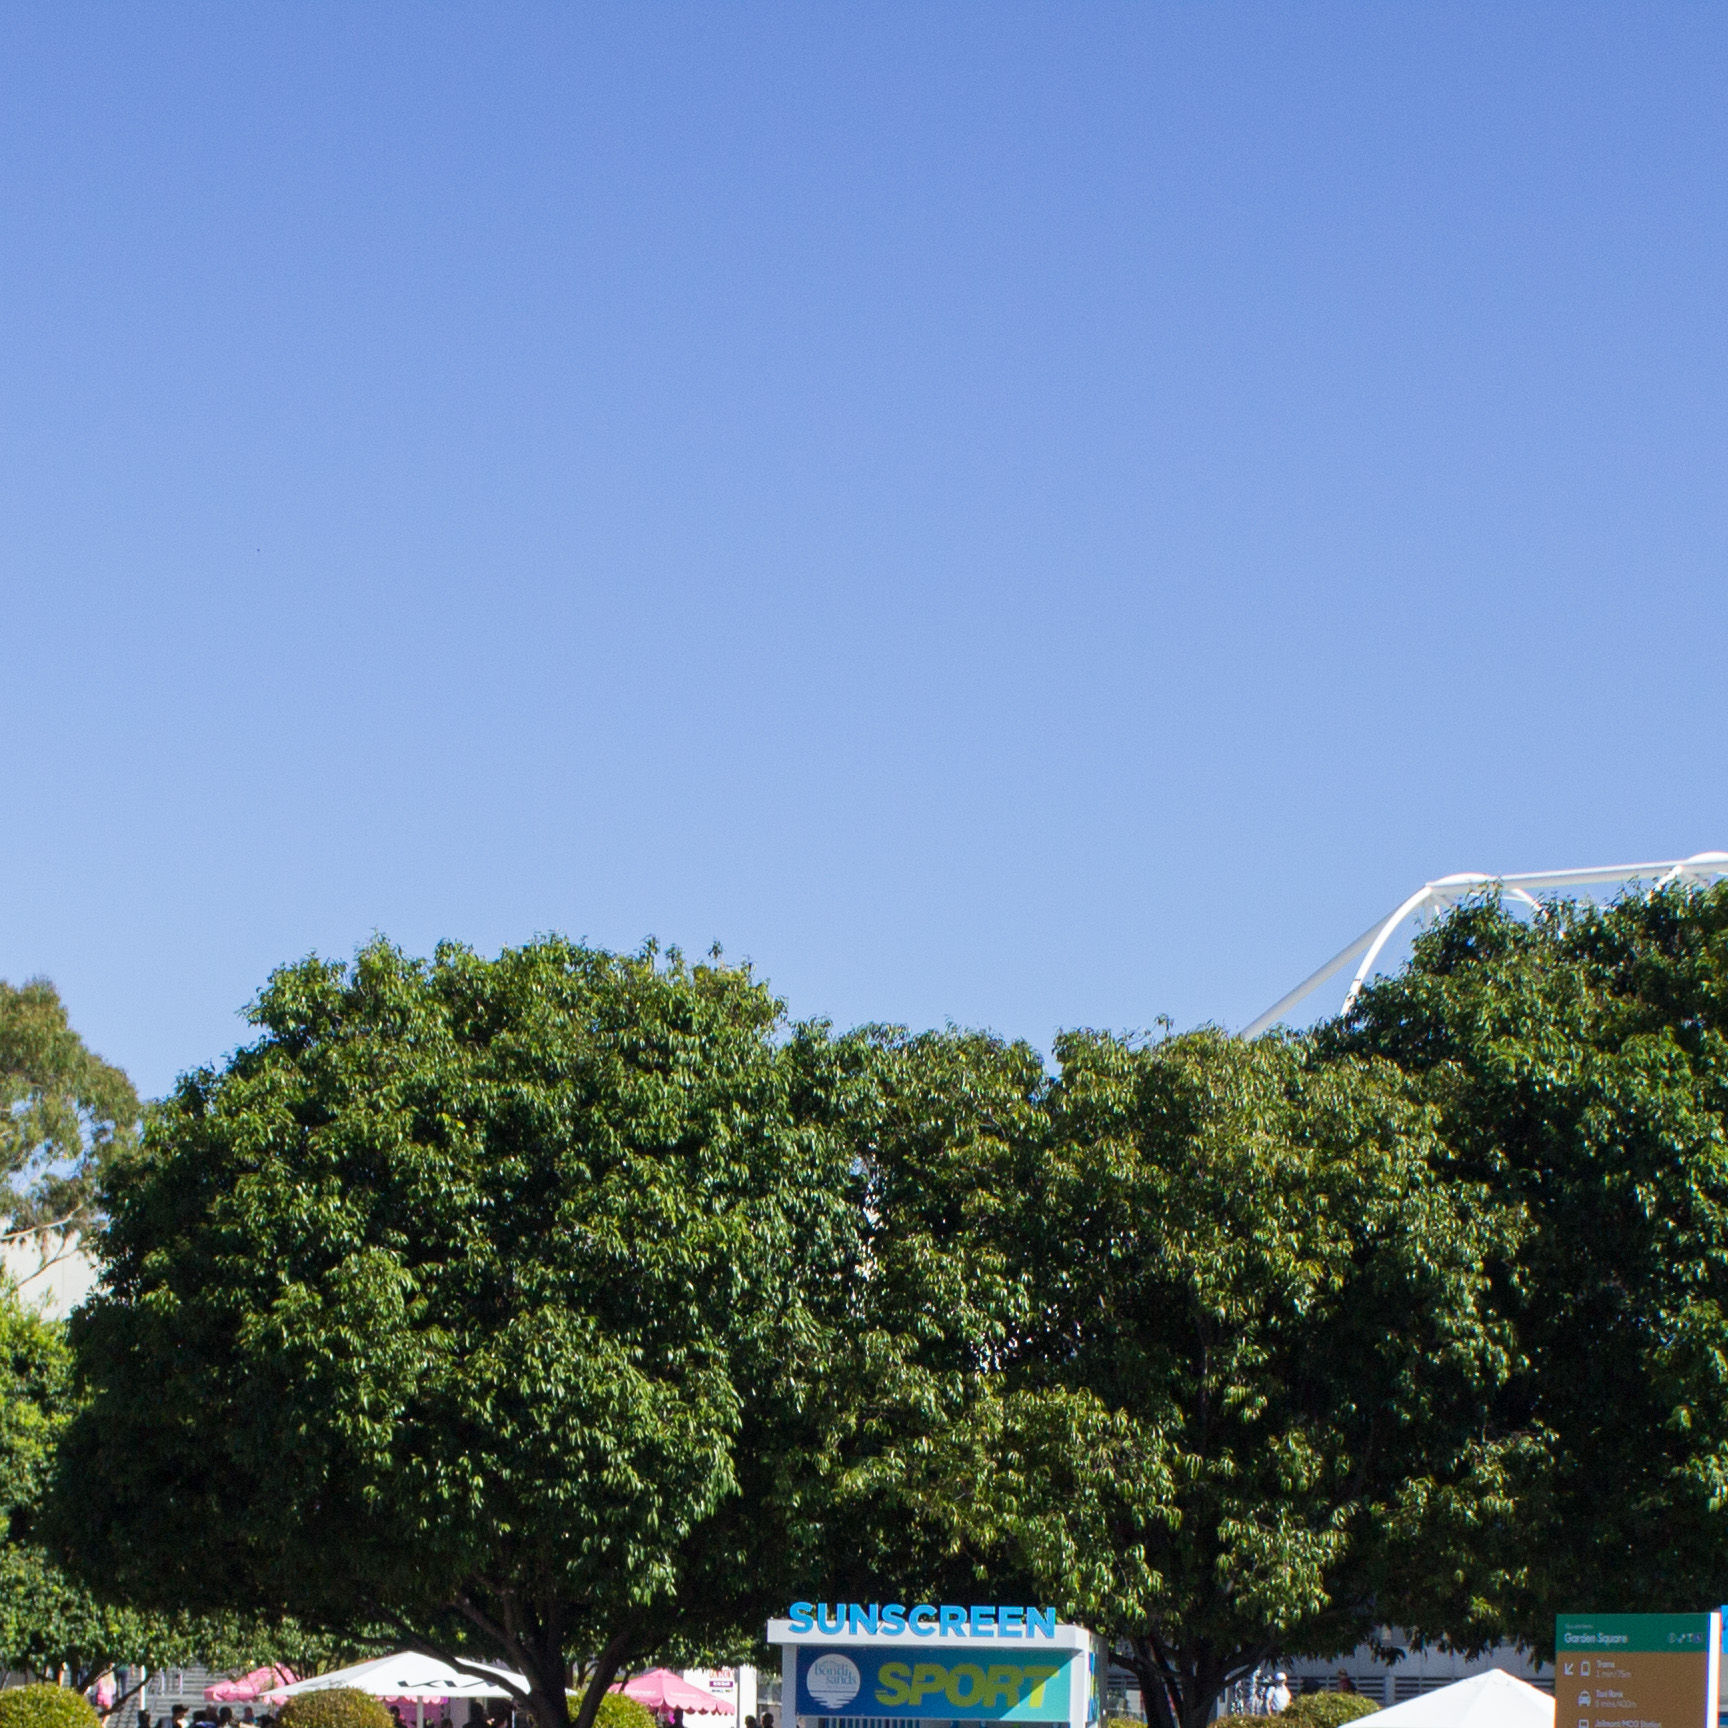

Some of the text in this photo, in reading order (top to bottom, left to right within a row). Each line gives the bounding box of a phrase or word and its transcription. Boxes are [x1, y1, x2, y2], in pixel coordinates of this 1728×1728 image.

[788, 1602, 1056, 1639] SUNSCREEN
[815, 1661, 849, 1676] bondi
[875, 1662, 1060, 1708] SPORT
